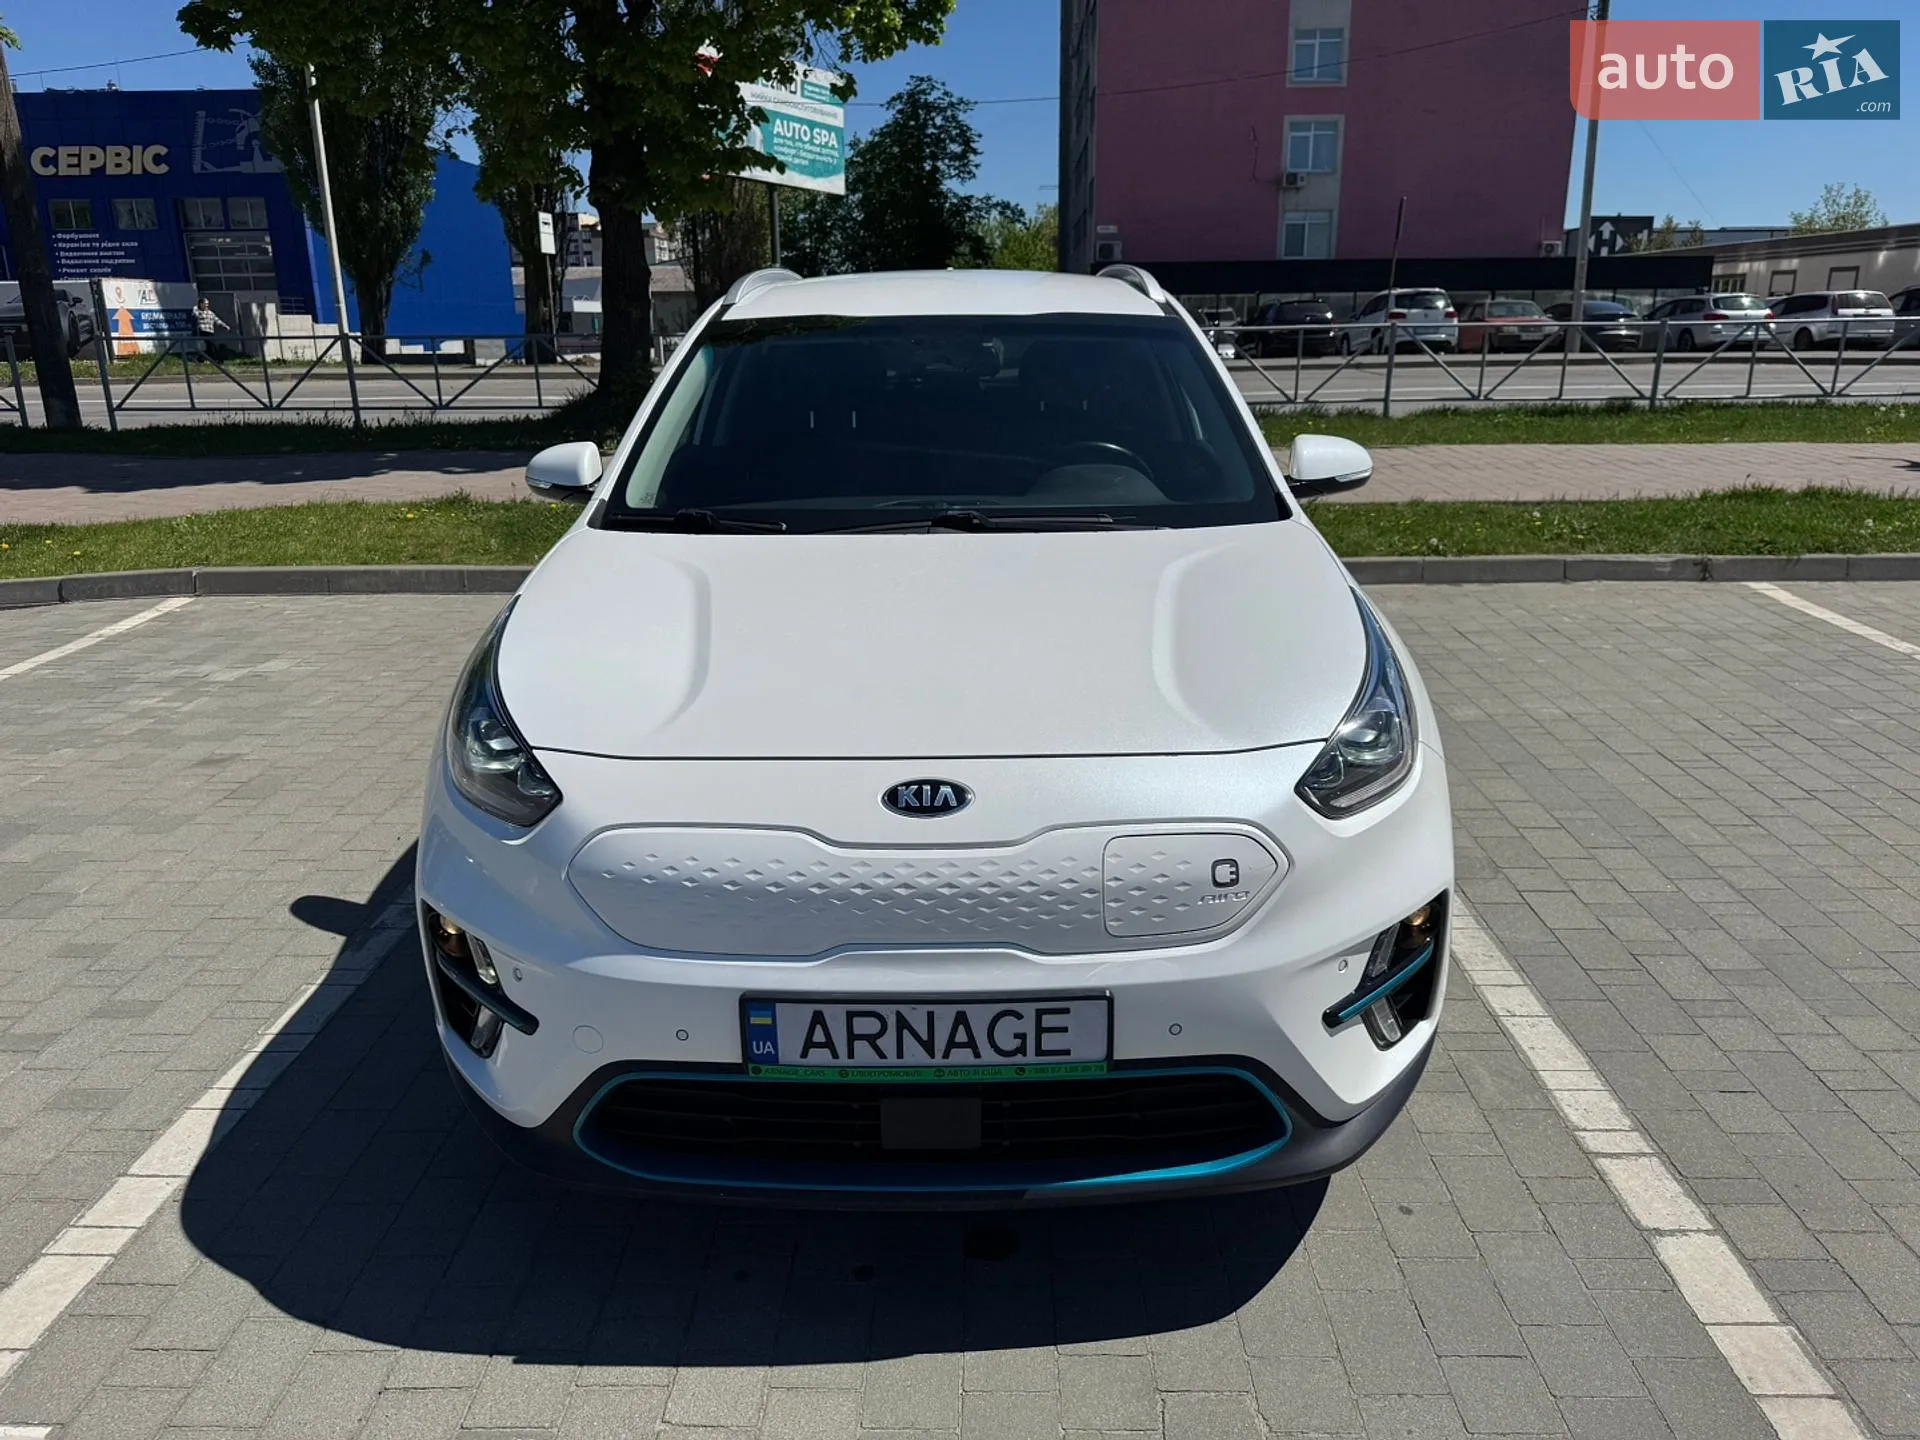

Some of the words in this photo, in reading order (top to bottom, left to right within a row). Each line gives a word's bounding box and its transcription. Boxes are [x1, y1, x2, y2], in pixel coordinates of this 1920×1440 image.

[774, 119, 811, 141] AUTO
[812, 128, 838, 148] SPA
[30, 145, 170, 176] СЕРВІС
[897, 785, 958, 808] KIA
[799, 1007, 1072, 1060] ARNAGE
[753, 1041, 775, 1056] UA
